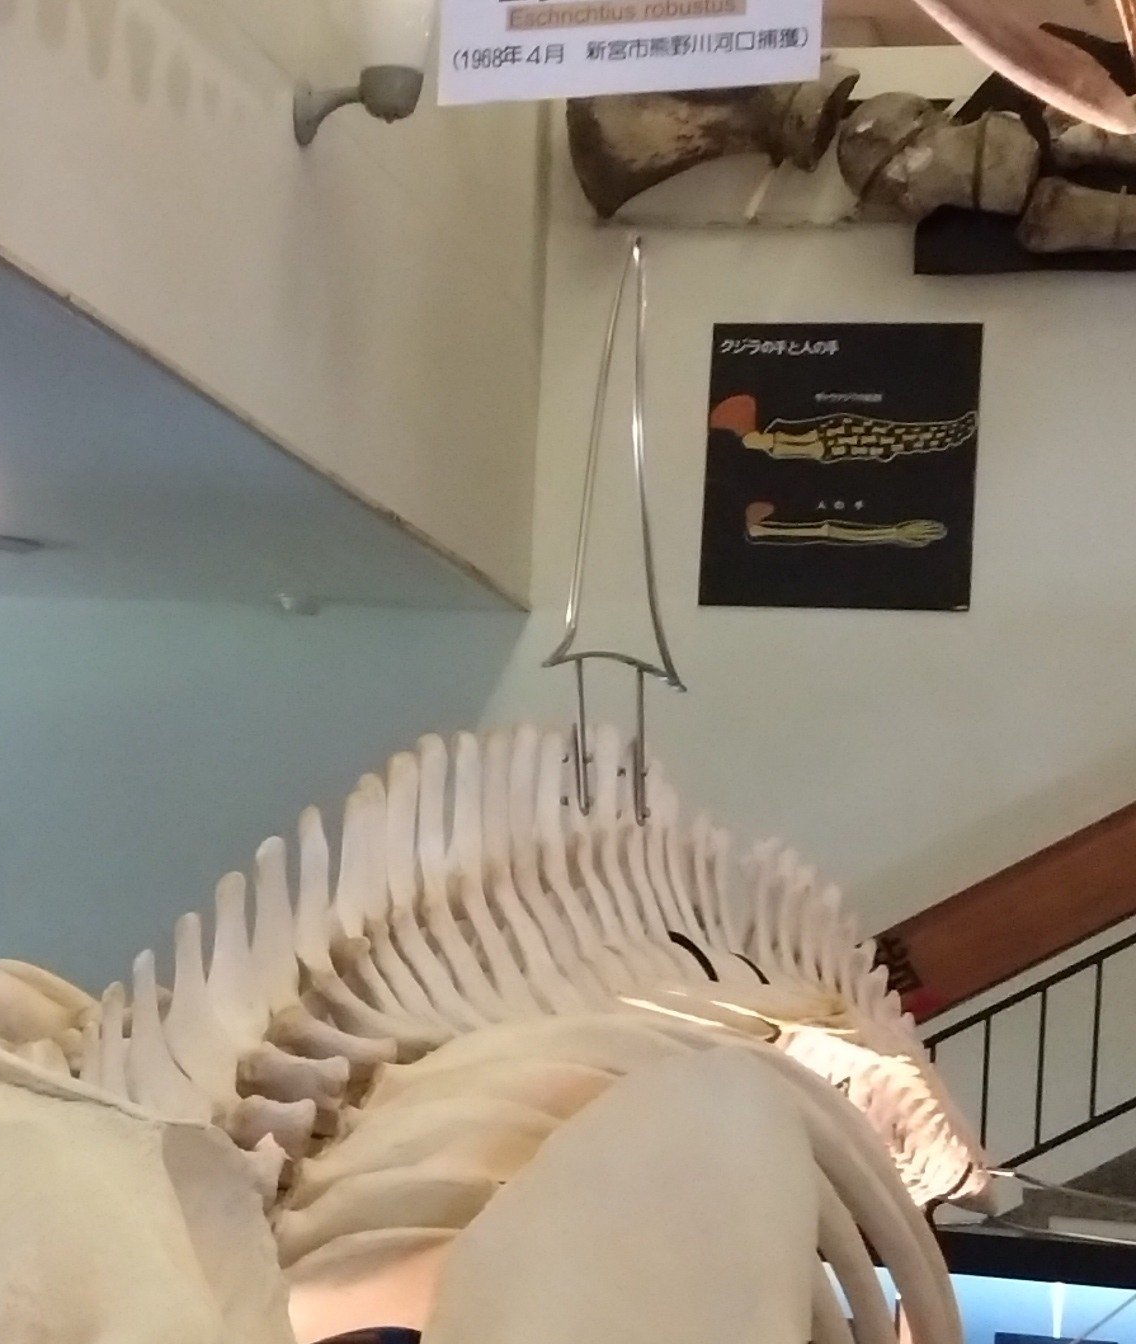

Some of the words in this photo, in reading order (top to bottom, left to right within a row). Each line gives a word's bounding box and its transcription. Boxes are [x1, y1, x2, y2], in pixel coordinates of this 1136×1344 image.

[721, 339, 840, 355] クジラの手と人の手
